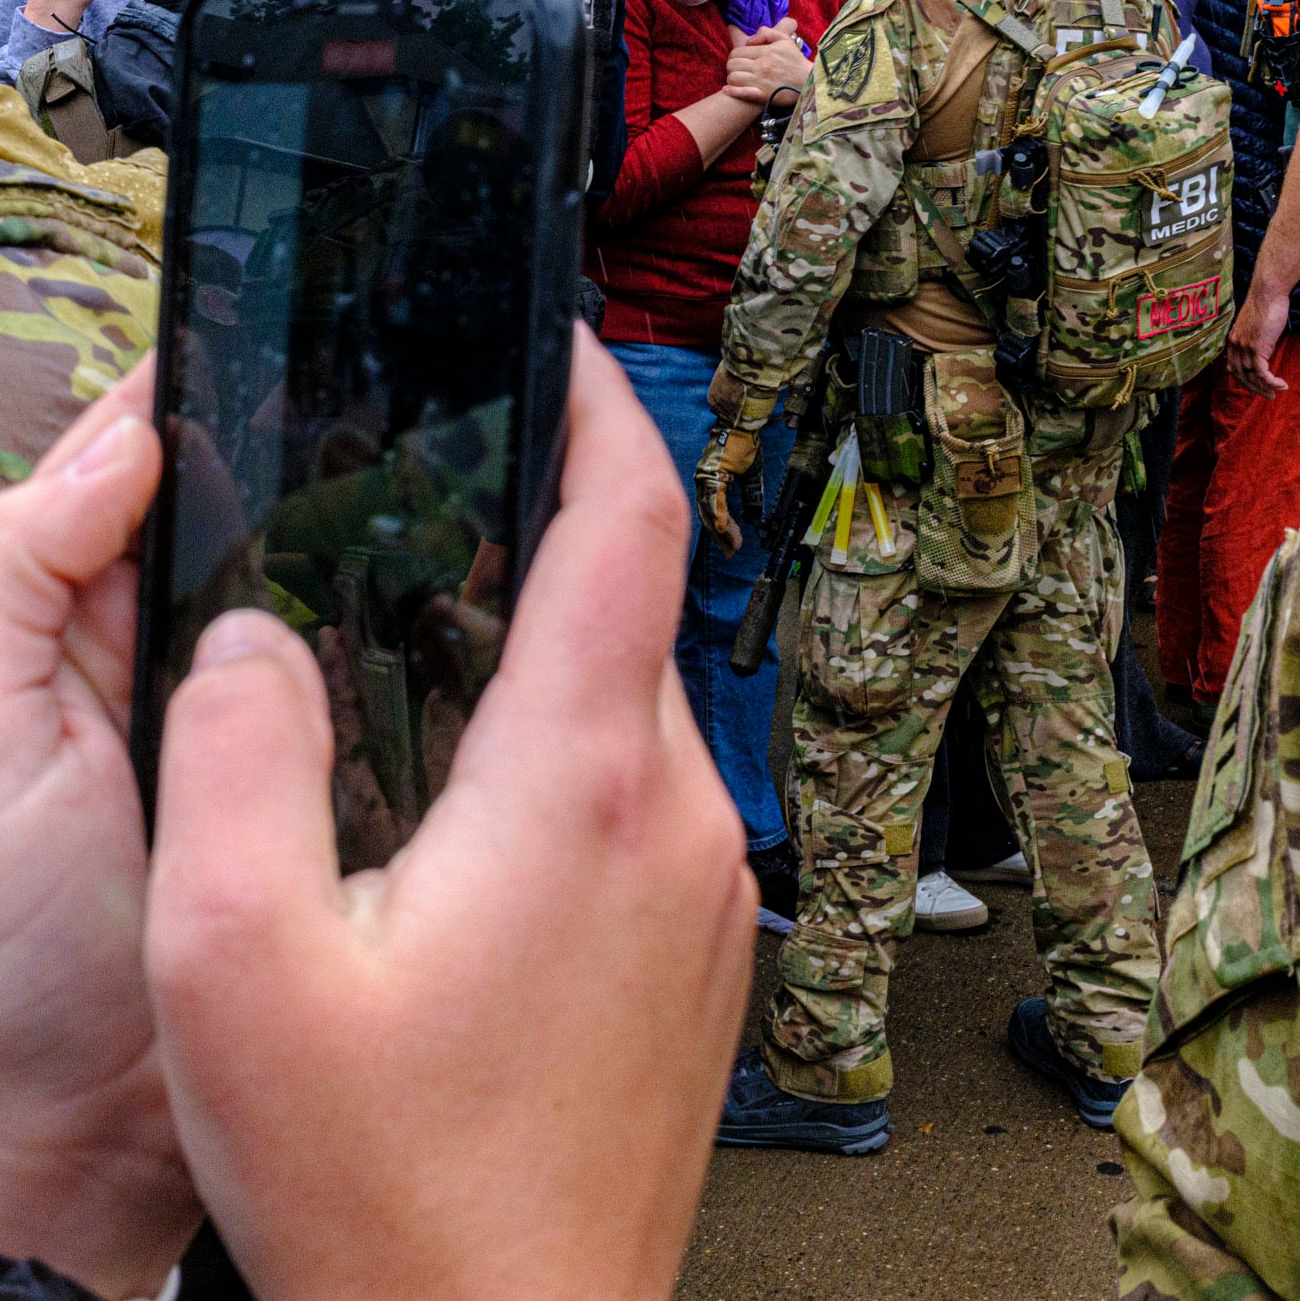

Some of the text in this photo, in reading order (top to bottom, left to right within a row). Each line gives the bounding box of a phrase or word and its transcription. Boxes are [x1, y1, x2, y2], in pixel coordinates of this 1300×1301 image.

[1150, 165, 1219, 225] FBI
[1150, 207, 1219, 241] MEDIC
[1150, 286, 1209, 329] MEDIC
